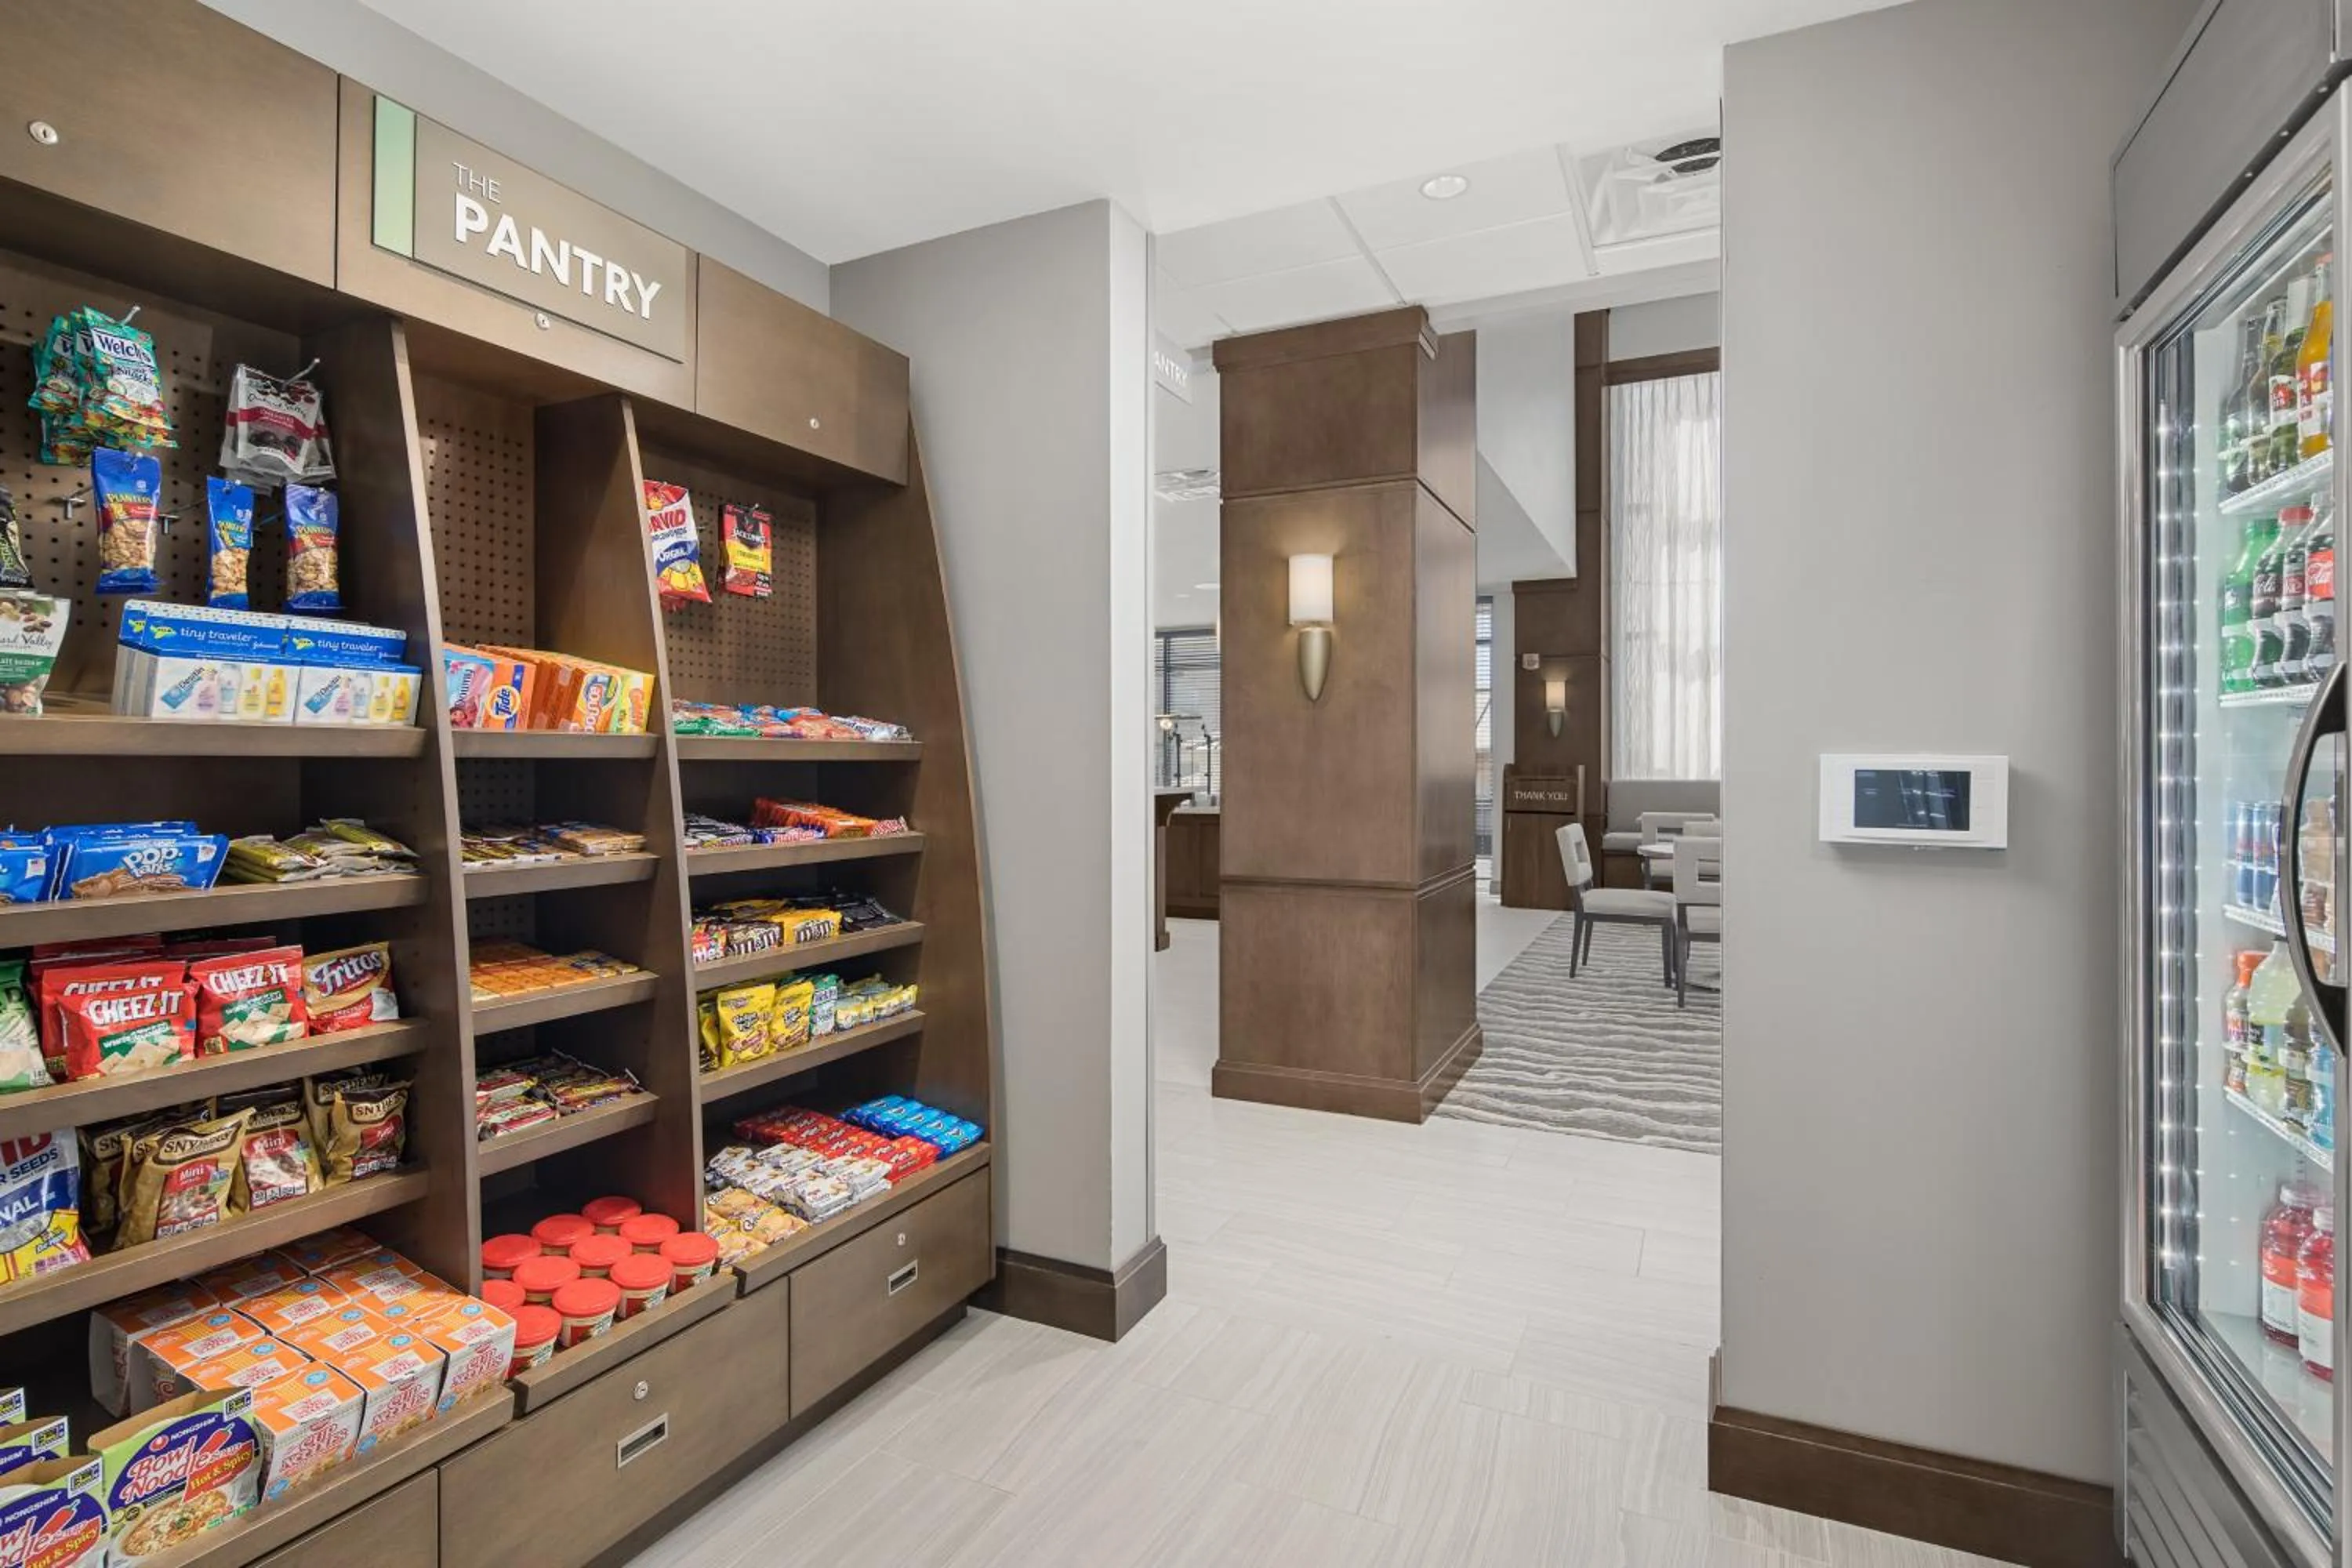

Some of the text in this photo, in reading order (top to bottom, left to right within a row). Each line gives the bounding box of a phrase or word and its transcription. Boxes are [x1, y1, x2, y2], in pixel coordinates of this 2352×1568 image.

[452, 162, 502, 203] THE
[453, 191, 662, 320] PANTRY
[1154, 350, 1188, 387] ANTRY
[649, 510, 686, 532] AVID
[180, 626, 252, 642] tiny traveler
[317, 639, 377, 652] tiny traveler
[493, 687, 511, 716] Tide
[1514, 790, 1569, 801] THANK YOU
[309, 950, 383, 997] Fritos
[9, 1148, 59, 1179] SEEDS
[179, 1163, 205, 1181] Mini
[126, 1434, 198, 1479] Bowl
[223, 1450, 251, 1469] Spicy
[118, 1450, 211, 1504] Noodle
[4, 1493, 59, 1523] NONGSHIM
[65, 1530, 96, 1550] Spicy
